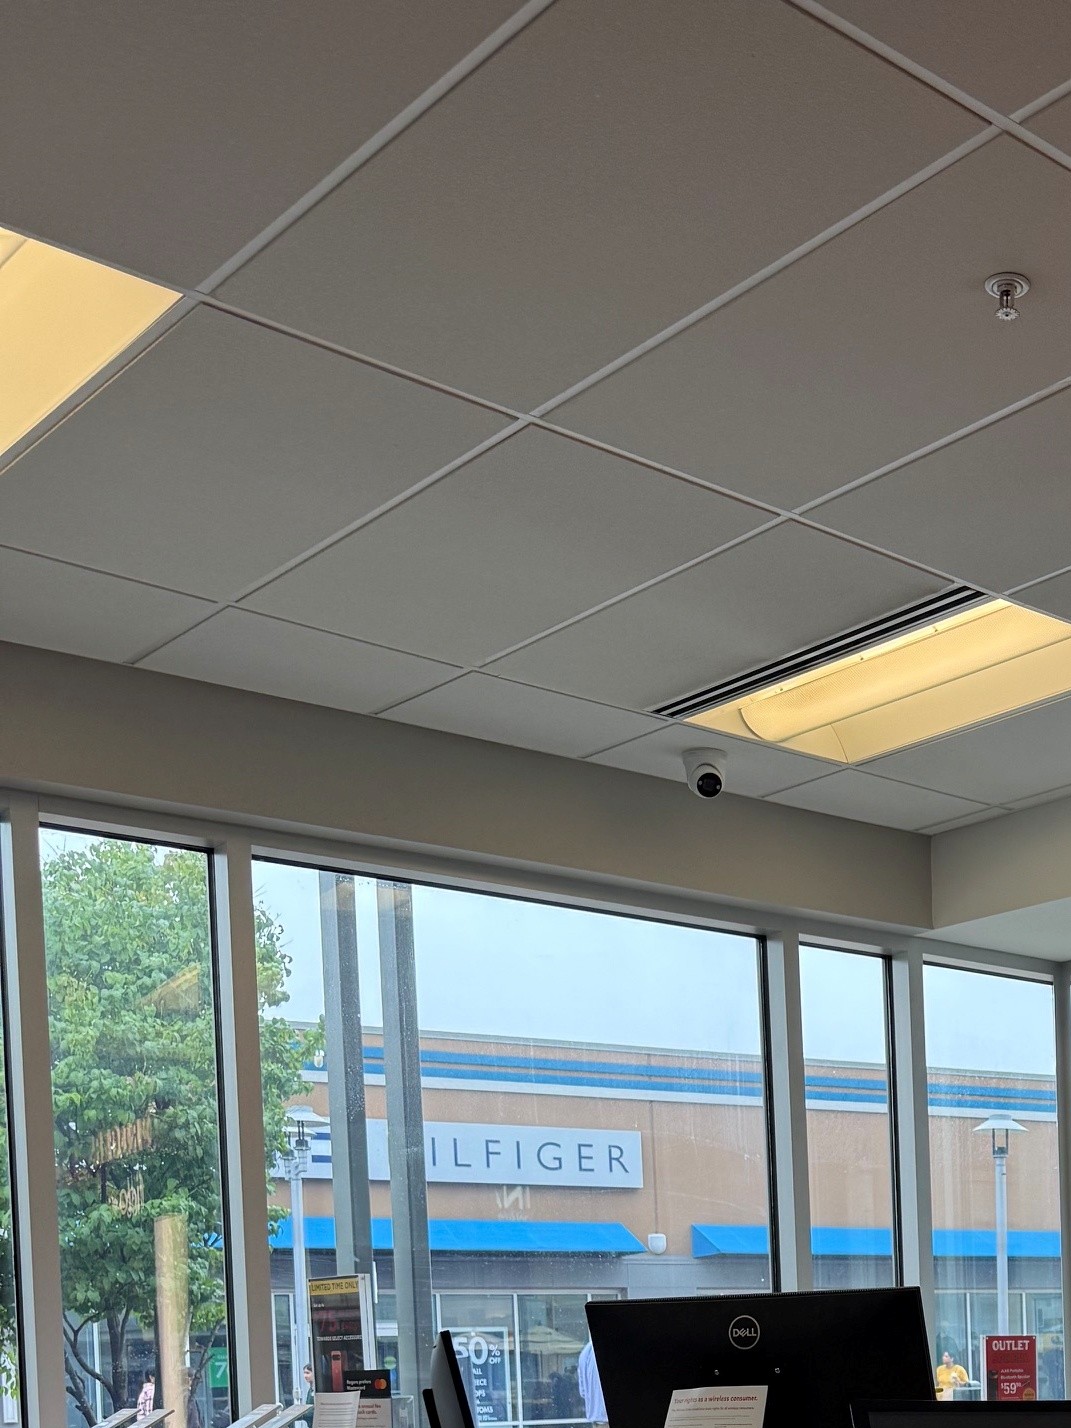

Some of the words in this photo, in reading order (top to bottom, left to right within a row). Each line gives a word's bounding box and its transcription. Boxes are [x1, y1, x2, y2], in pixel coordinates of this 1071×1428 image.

[431, 1136, 630, 1174] ILFIGER
[311, 1282, 331, 1292] LIMITED
[332, 1281, 344, 1290] TIME
[344, 1280, 359, 1290] ONLY
[732, 1328, 757, 1338] DELL
[991, 1339, 1030, 1351] OUTLET
[489, 1357, 501, 1365] OFF
